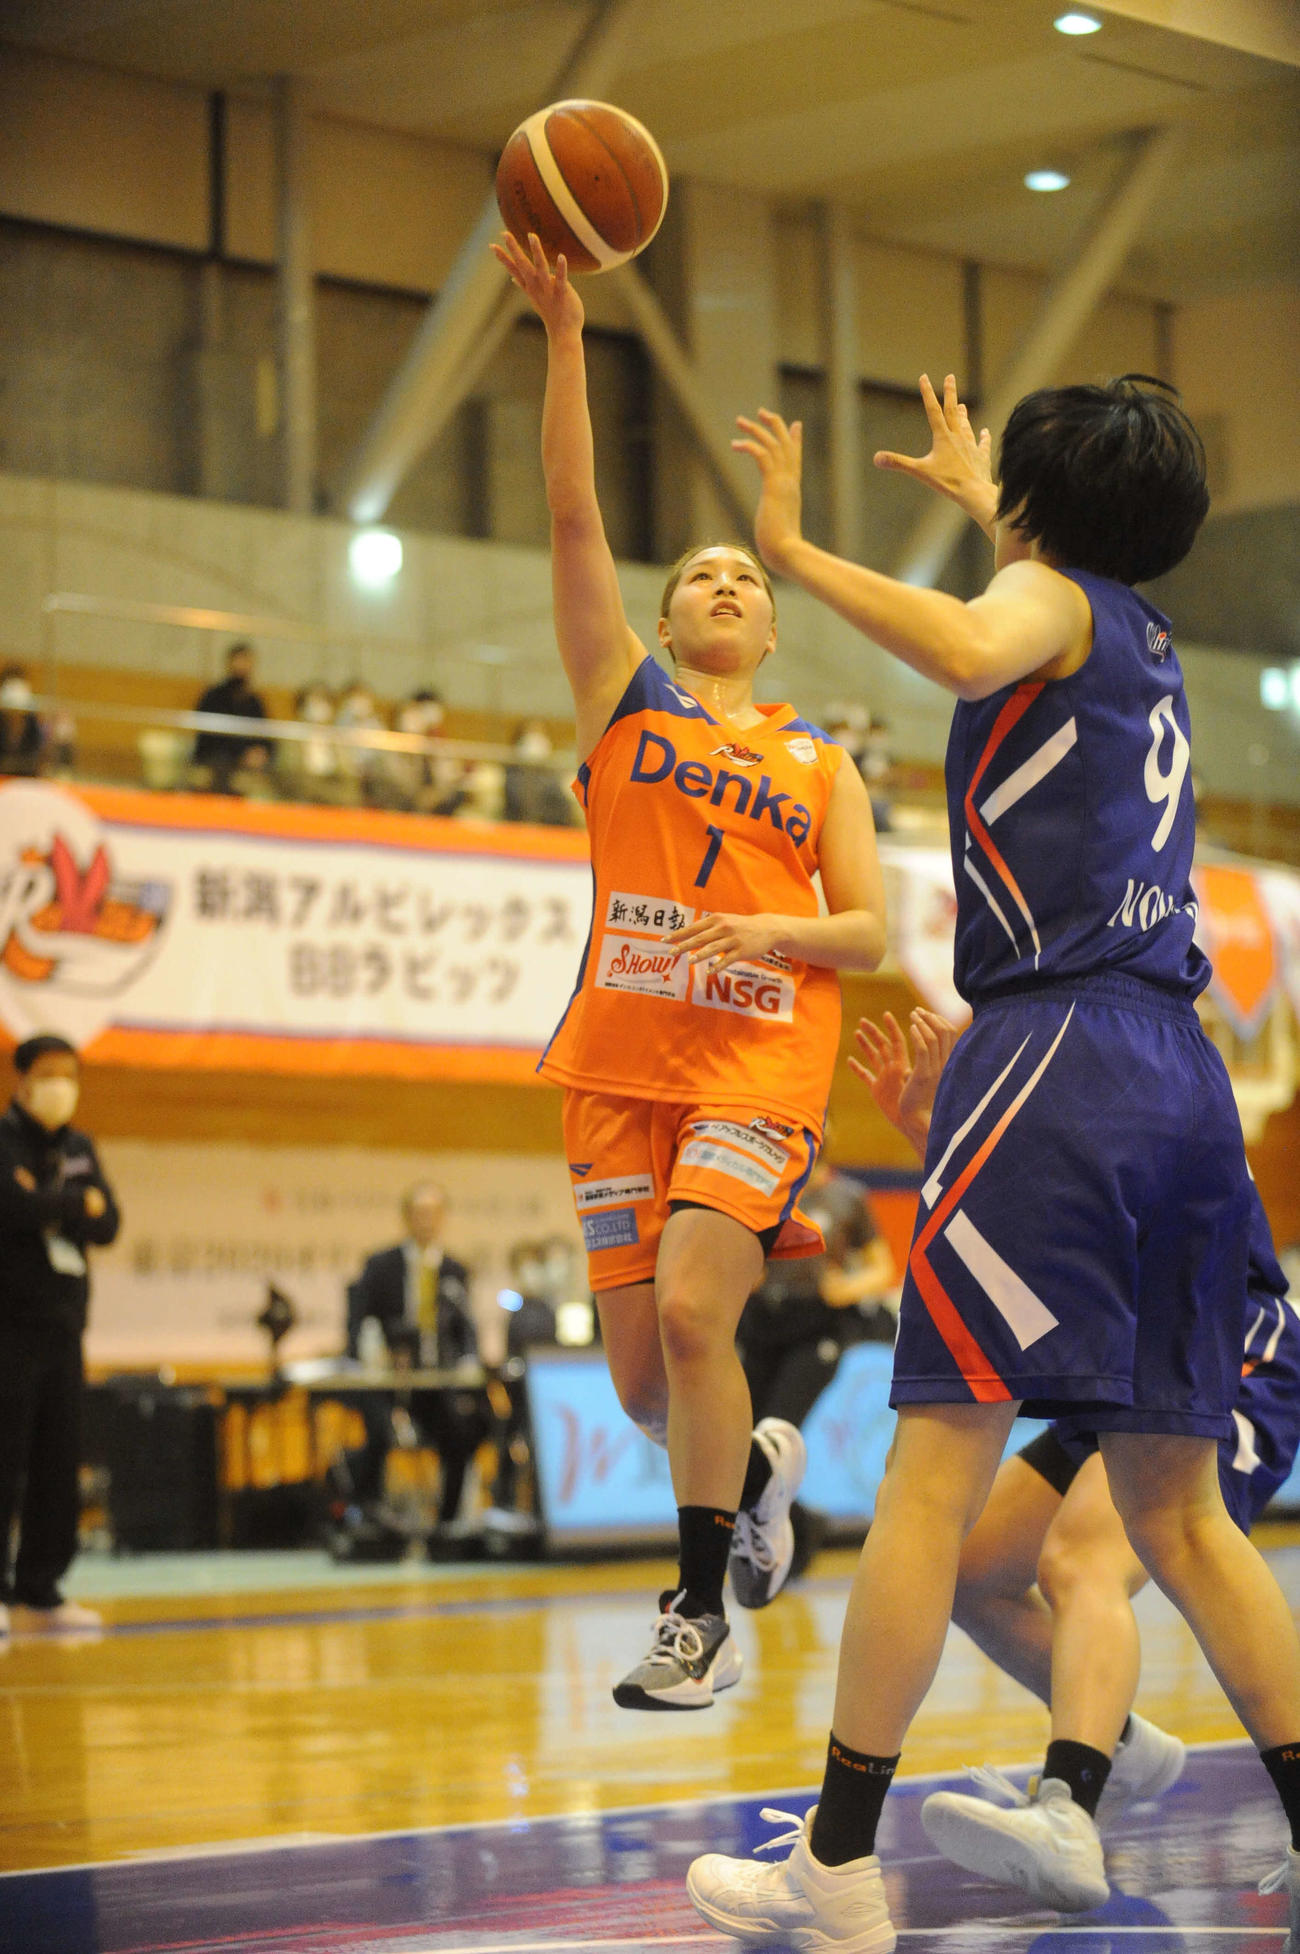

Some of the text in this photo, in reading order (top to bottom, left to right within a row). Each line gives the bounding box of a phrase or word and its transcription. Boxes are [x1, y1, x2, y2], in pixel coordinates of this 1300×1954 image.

[630, 730, 811, 848] Denka
[1144, 695, 1190, 852] 9
[694, 825, 725, 888] 1
[706, 974, 781, 1014] NSG
